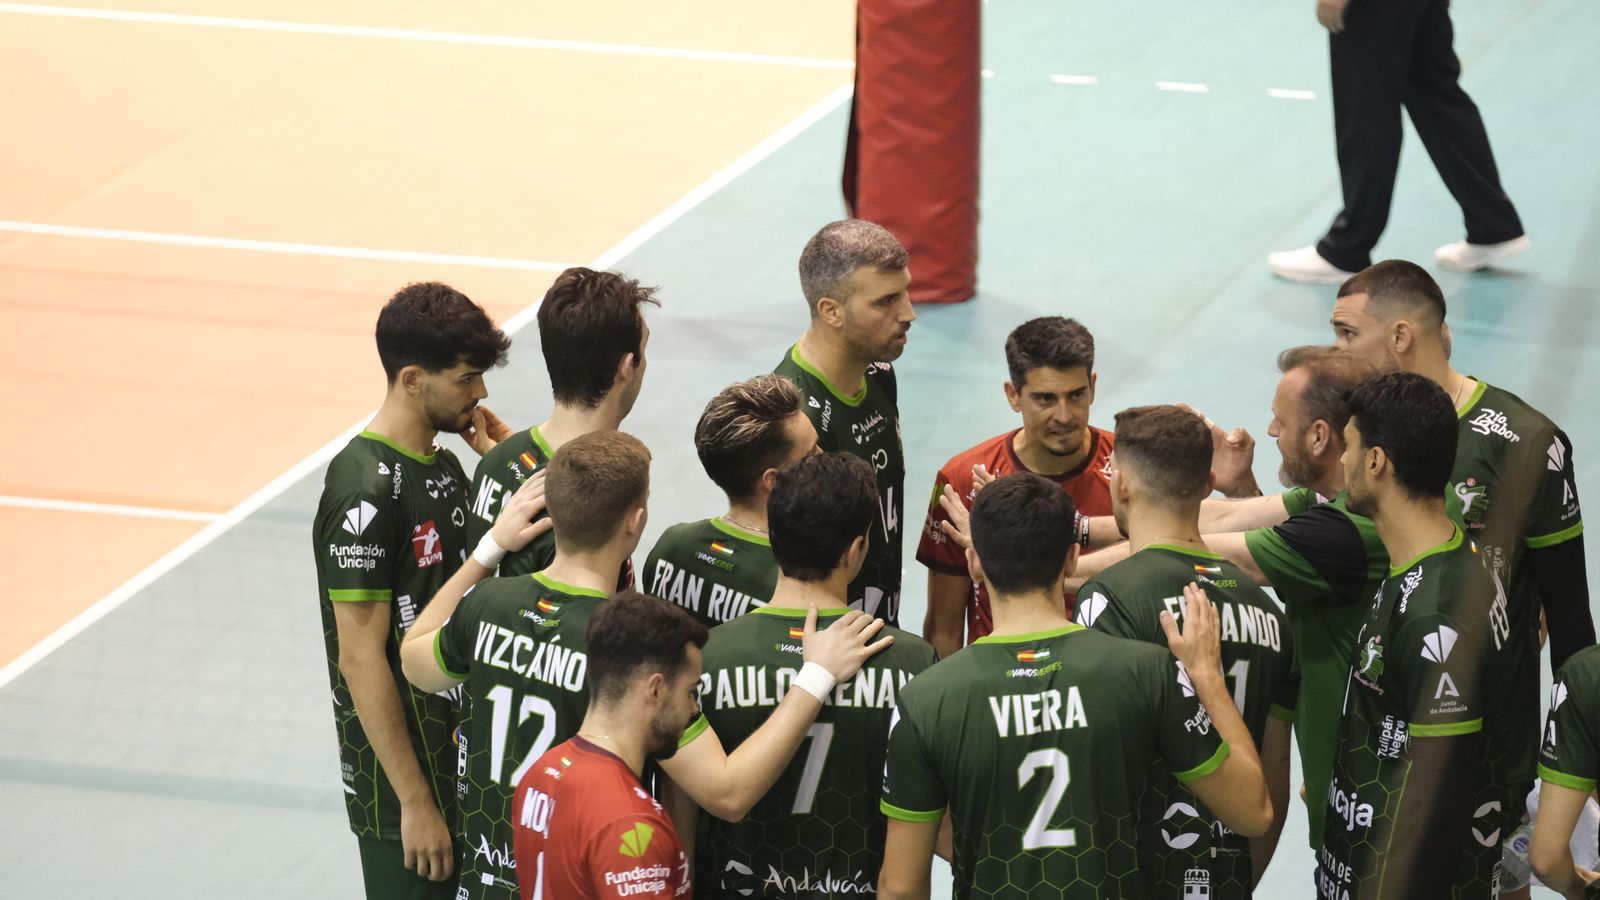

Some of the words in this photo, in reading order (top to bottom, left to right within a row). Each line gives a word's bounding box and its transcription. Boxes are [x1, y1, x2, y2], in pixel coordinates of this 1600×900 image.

[330, 543, 386, 558] Fundación
[338, 556, 376, 571] Unicaja
[418, 551, 443, 568] SVM
[651, 558, 705, 613] FRAN
[707, 582, 769, 624] RUI
[474, 620, 588, 693] VIZCAÍNO
[988, 685, 1089, 738] VIERA
[485, 683, 557, 788] 12
[1377, 714, 1395, 757] Tulipán
[1388, 719, 1406, 759] Negro
[790, 722, 835, 815] 7
[1017, 747, 1077, 850] 2
[762, 863, 878, 894] Andalucía
